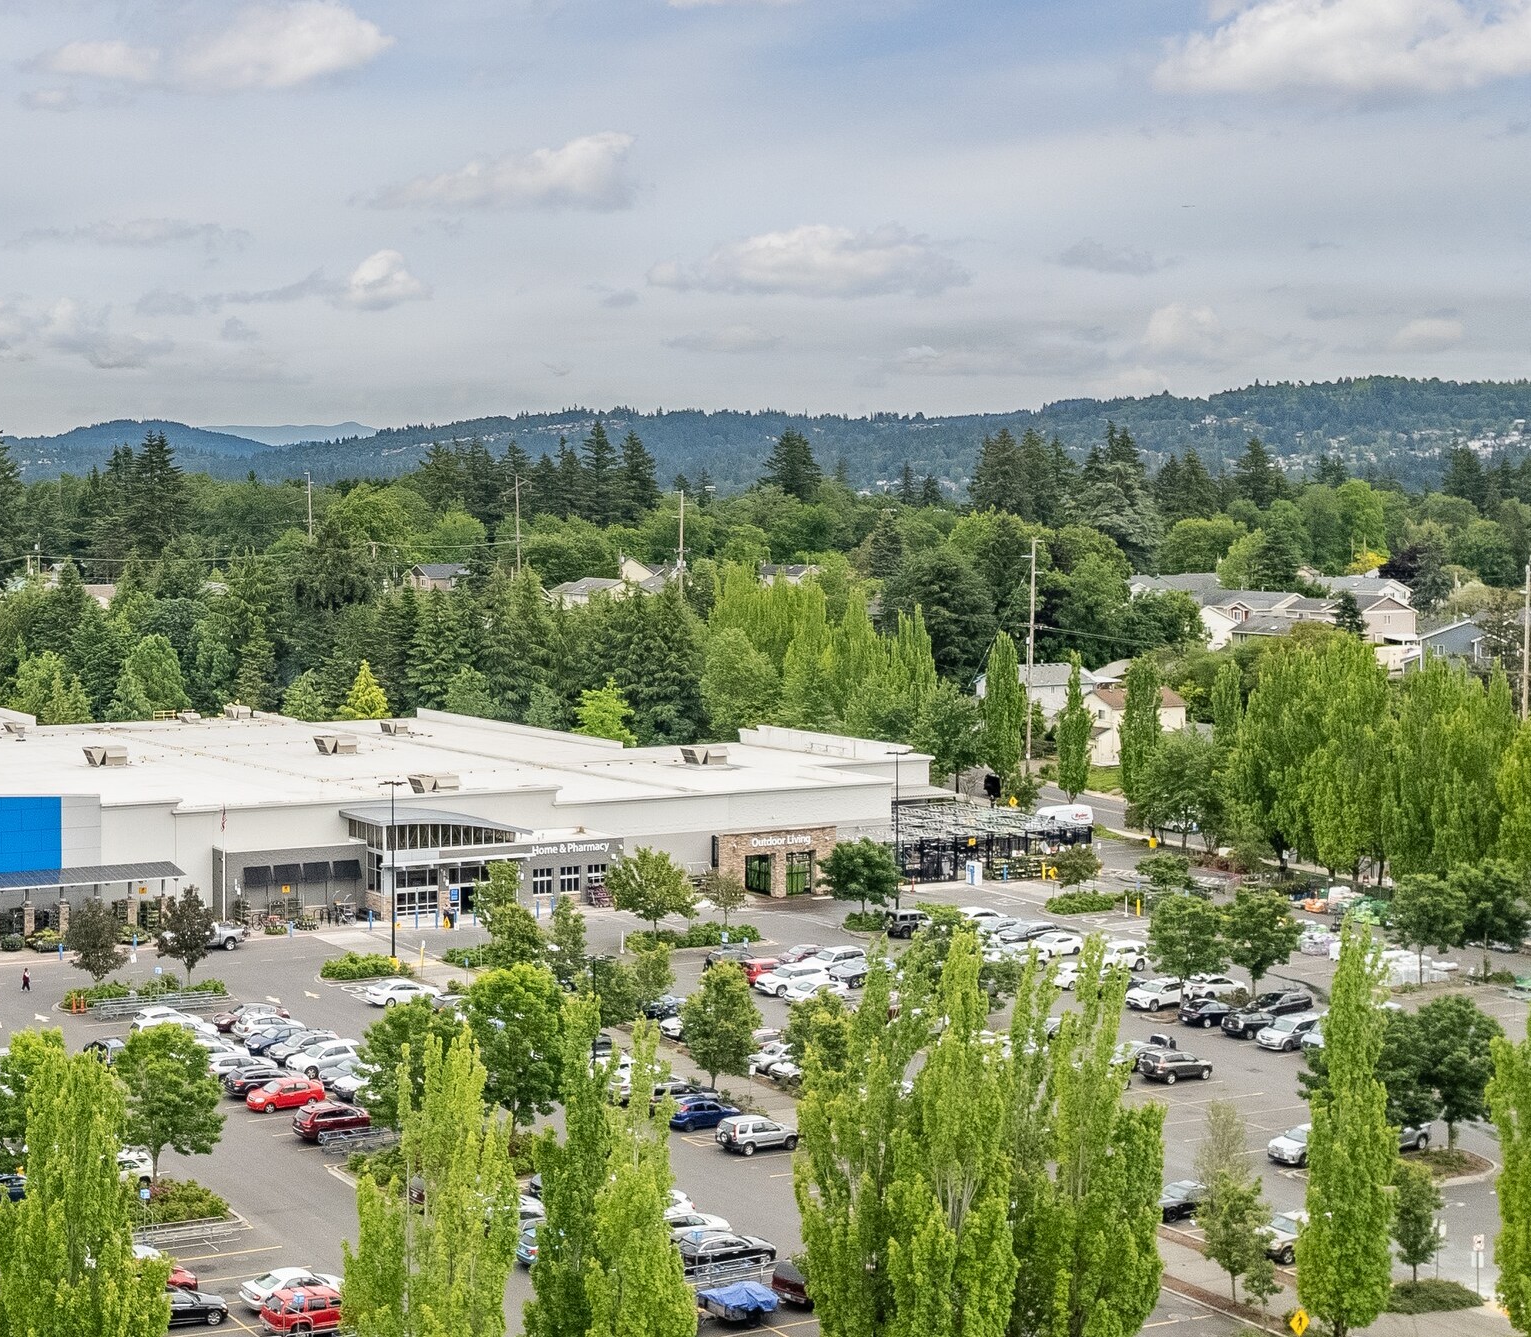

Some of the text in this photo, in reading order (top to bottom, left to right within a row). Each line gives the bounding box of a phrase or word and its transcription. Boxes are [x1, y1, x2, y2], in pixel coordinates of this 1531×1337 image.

[751, 834, 811, 847] Outdoor Living
[532, 842, 609, 855] Home & Pharmacy
